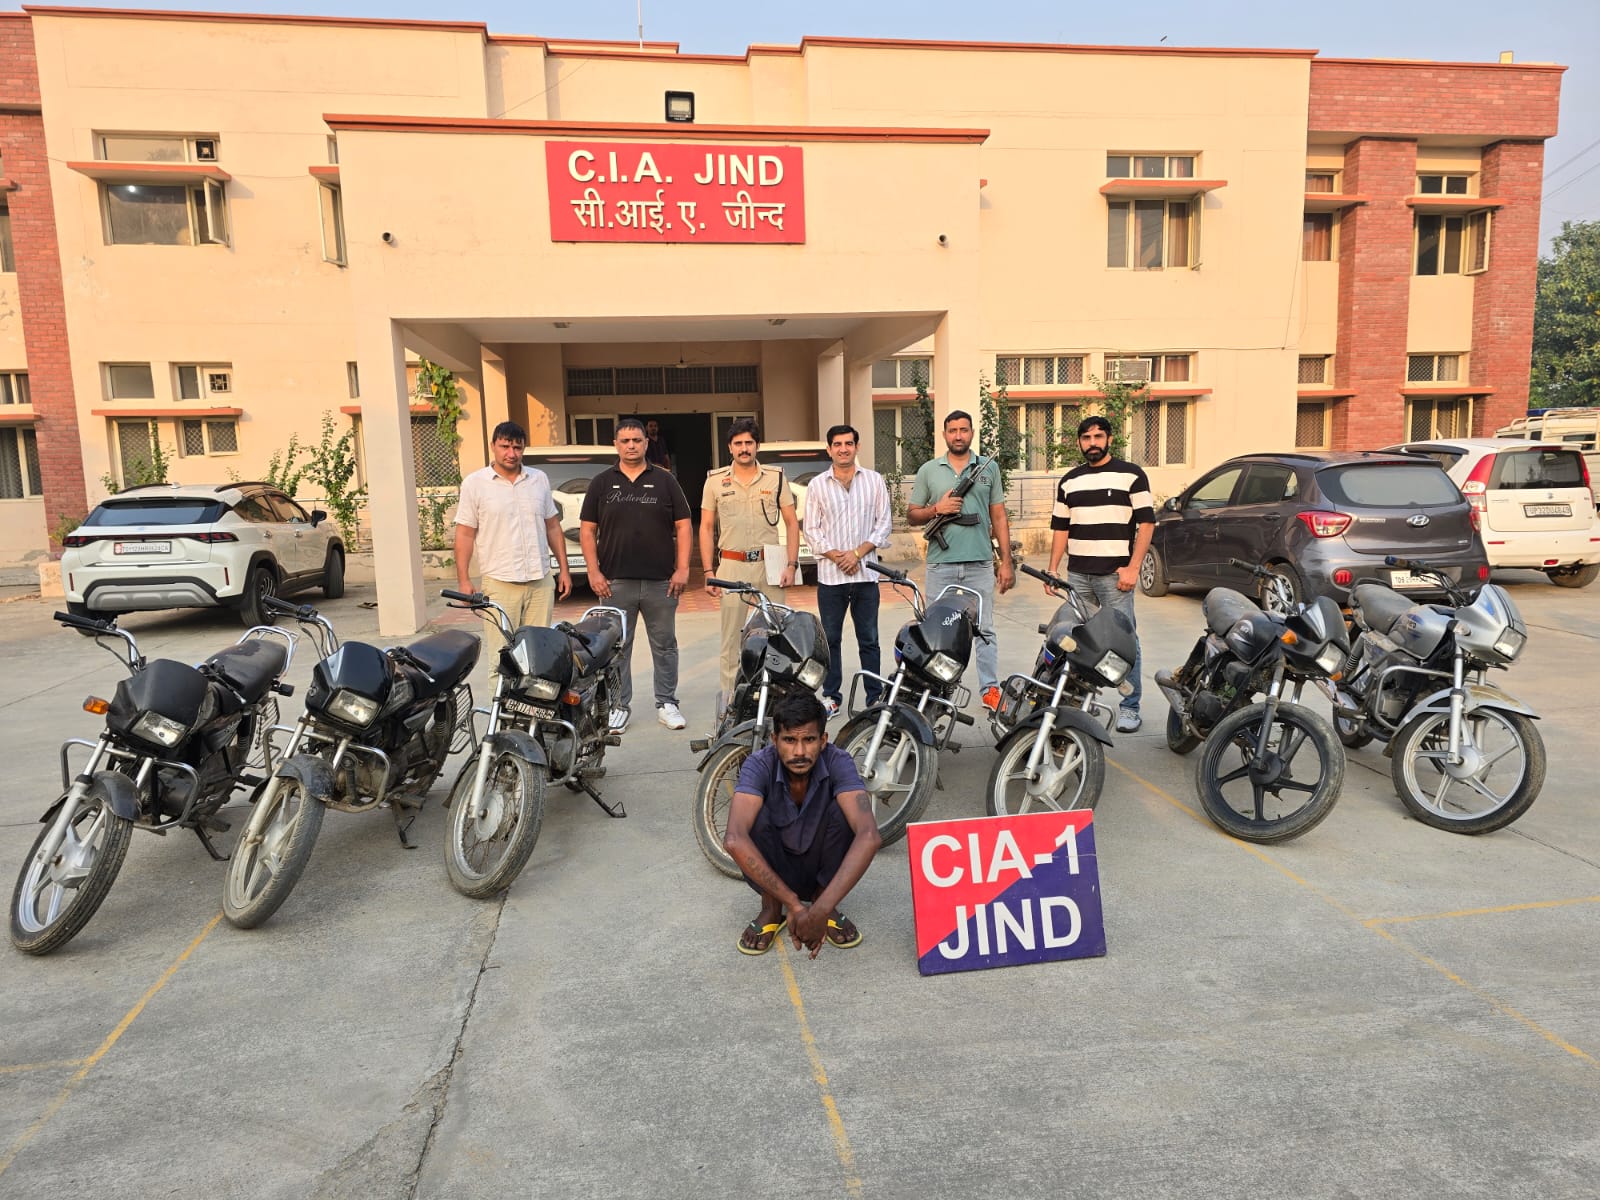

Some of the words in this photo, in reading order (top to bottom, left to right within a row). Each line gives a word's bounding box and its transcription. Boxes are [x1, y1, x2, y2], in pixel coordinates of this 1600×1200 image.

[568, 150, 673, 183] C.I.A.
[694, 153, 784, 186] JIND
[721, 190, 785, 231] जीन्द
[606, 490, 658, 504] Rotterdam
[921, 824, 1080, 888] CIA-1
[938, 896, 1082, 960] JIND
